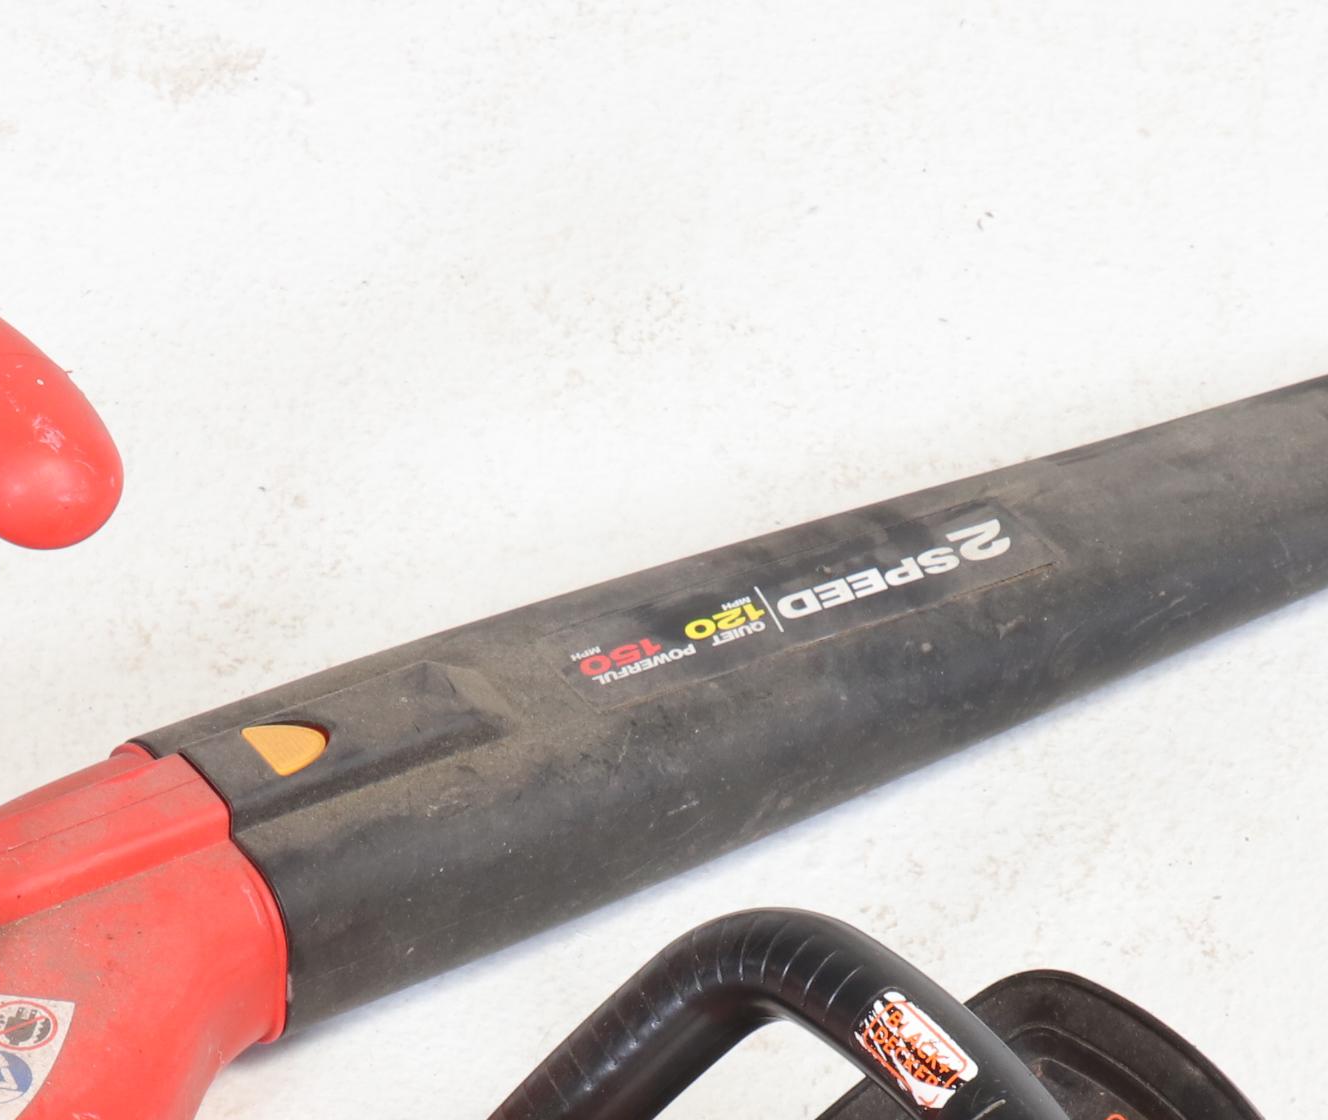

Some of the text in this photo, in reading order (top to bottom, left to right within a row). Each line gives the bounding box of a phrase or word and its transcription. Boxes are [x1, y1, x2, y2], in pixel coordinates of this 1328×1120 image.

[684, 603, 765, 640] 120
[721, 596, 751, 611] MPH
[711, 620, 766, 647] QUIET
[570, 646, 601, 662] MPH
[579, 638, 662, 676] 150
[592, 643, 696, 685] POWERFUL
[885, 1008, 955, 1077] BLACK+
